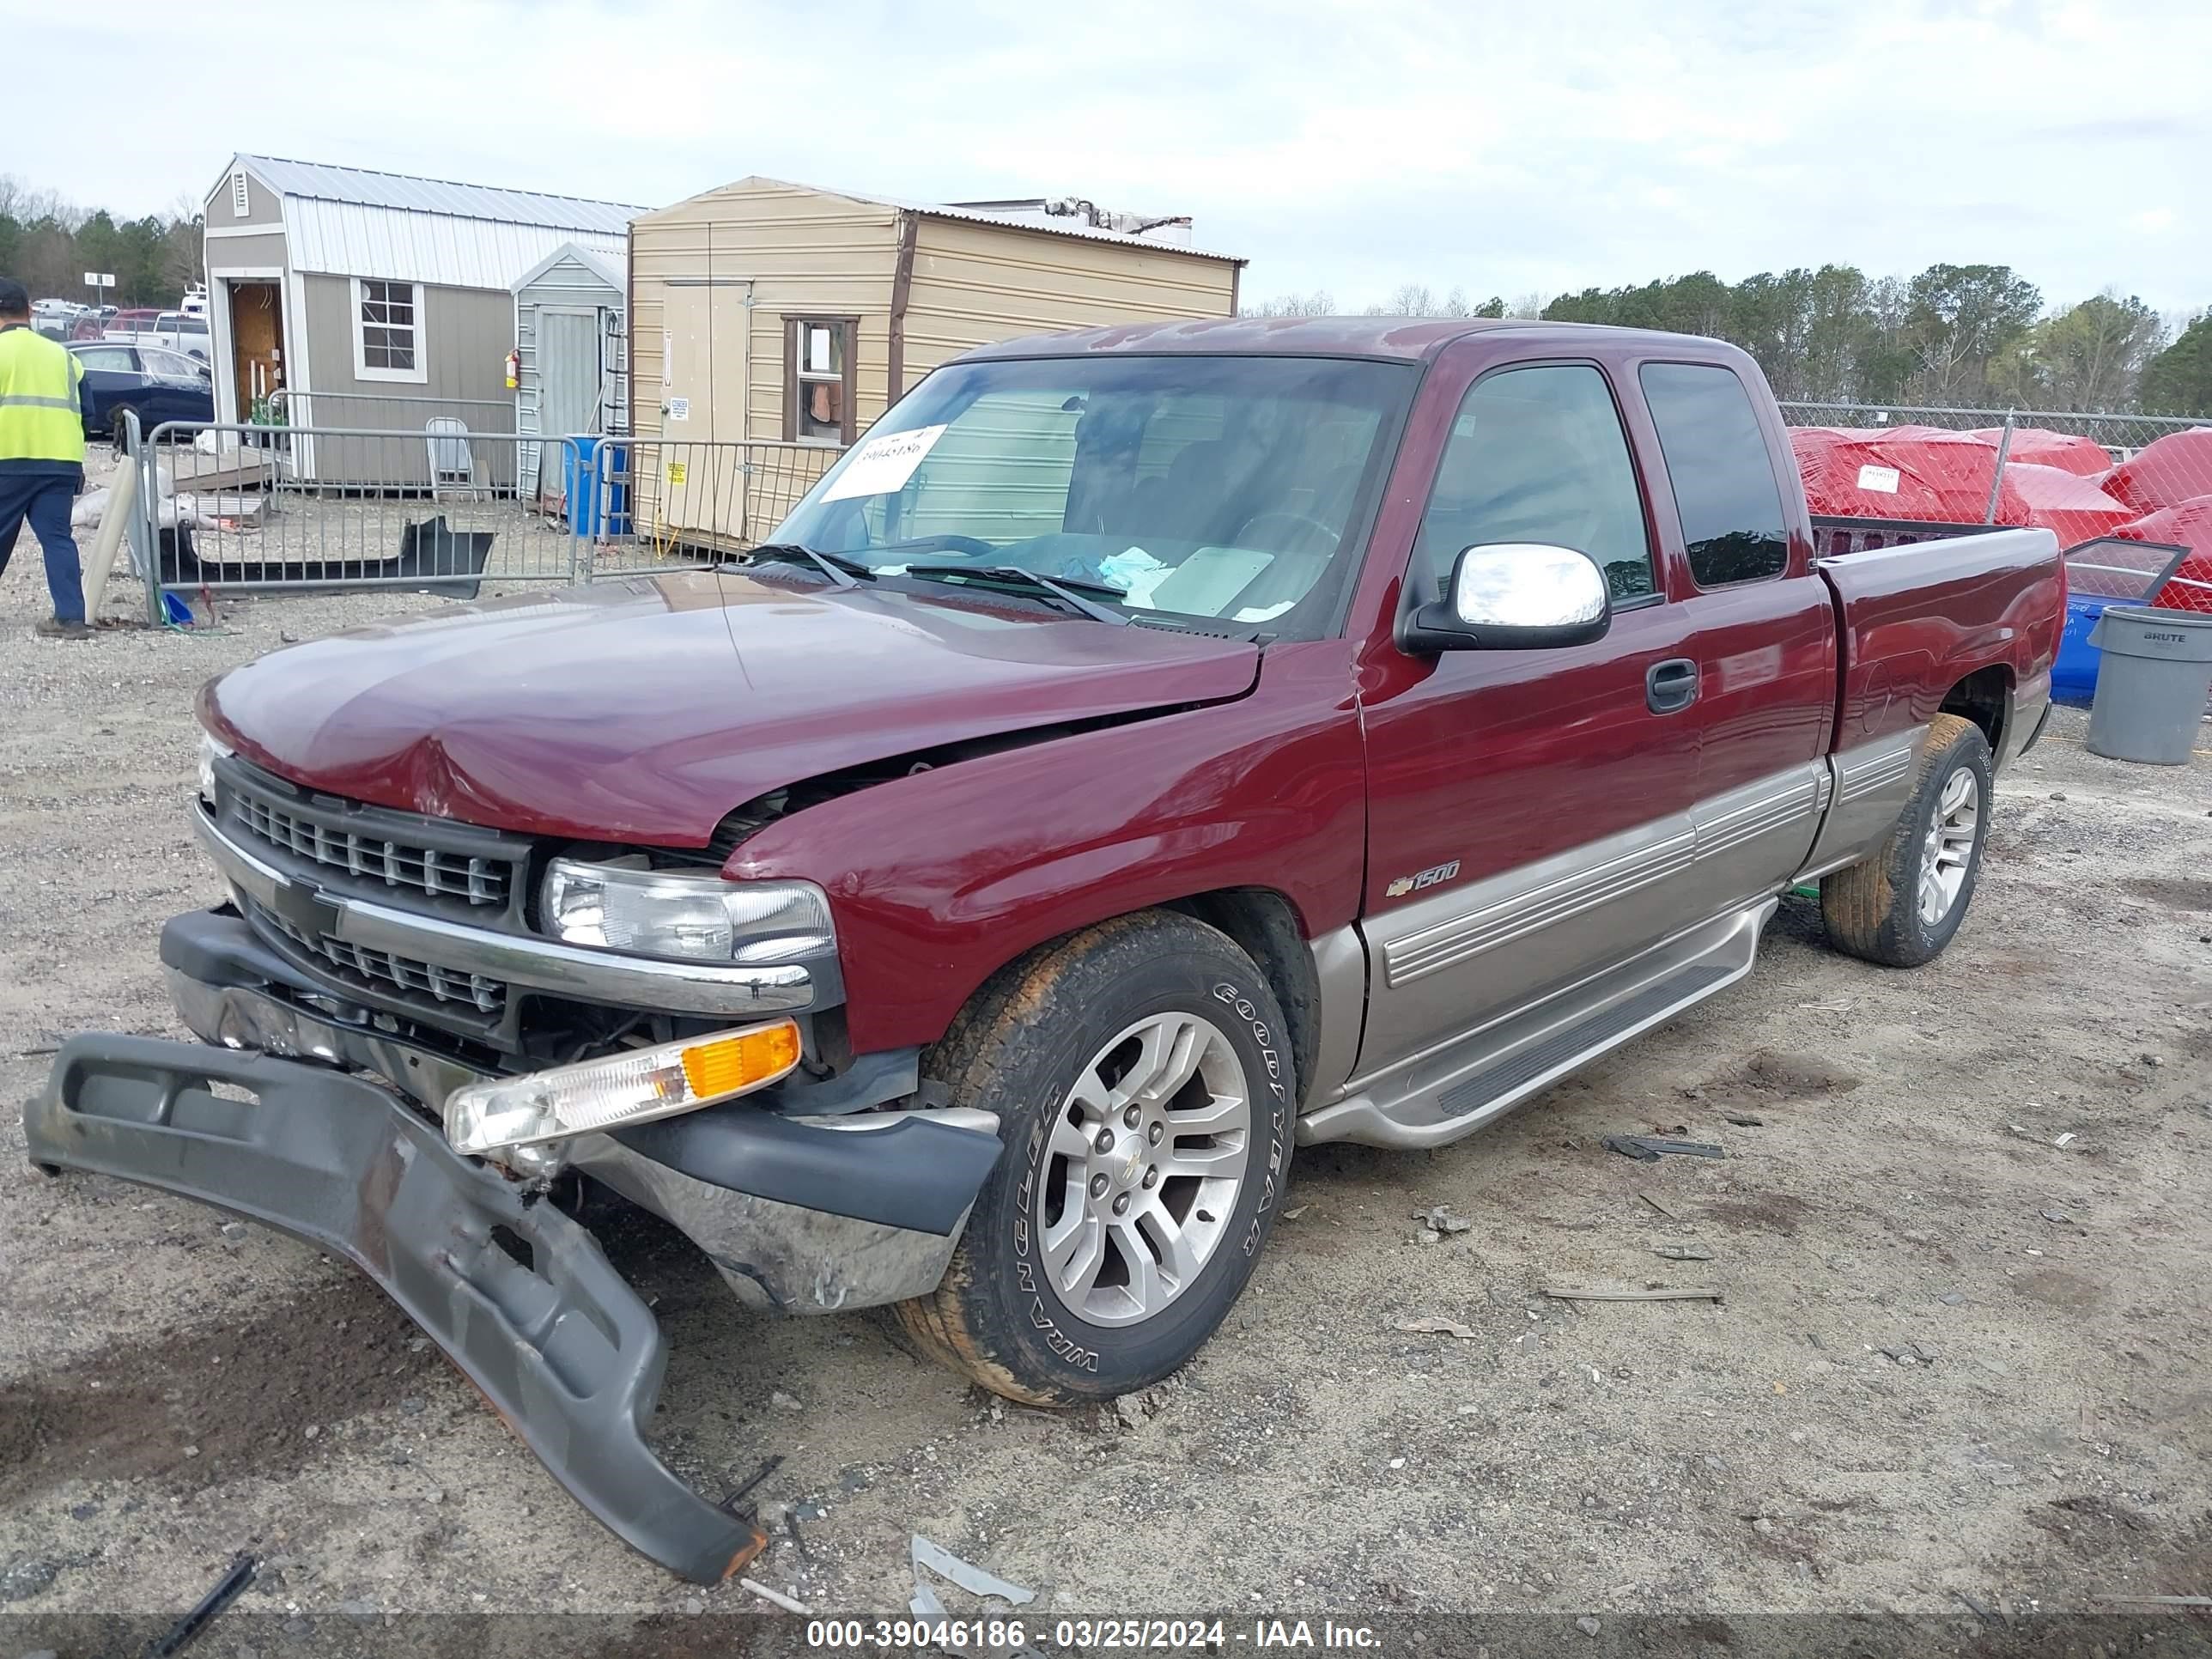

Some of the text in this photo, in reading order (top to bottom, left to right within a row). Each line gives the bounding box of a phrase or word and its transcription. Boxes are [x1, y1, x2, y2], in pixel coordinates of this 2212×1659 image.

[2143, 631, 2185, 643] BRUTE
[1414, 860, 1461, 890] 1500
[1212, 981, 1285, 1257] GOODYEAR
[1014, 1083, 1100, 1373] WRANGLER
